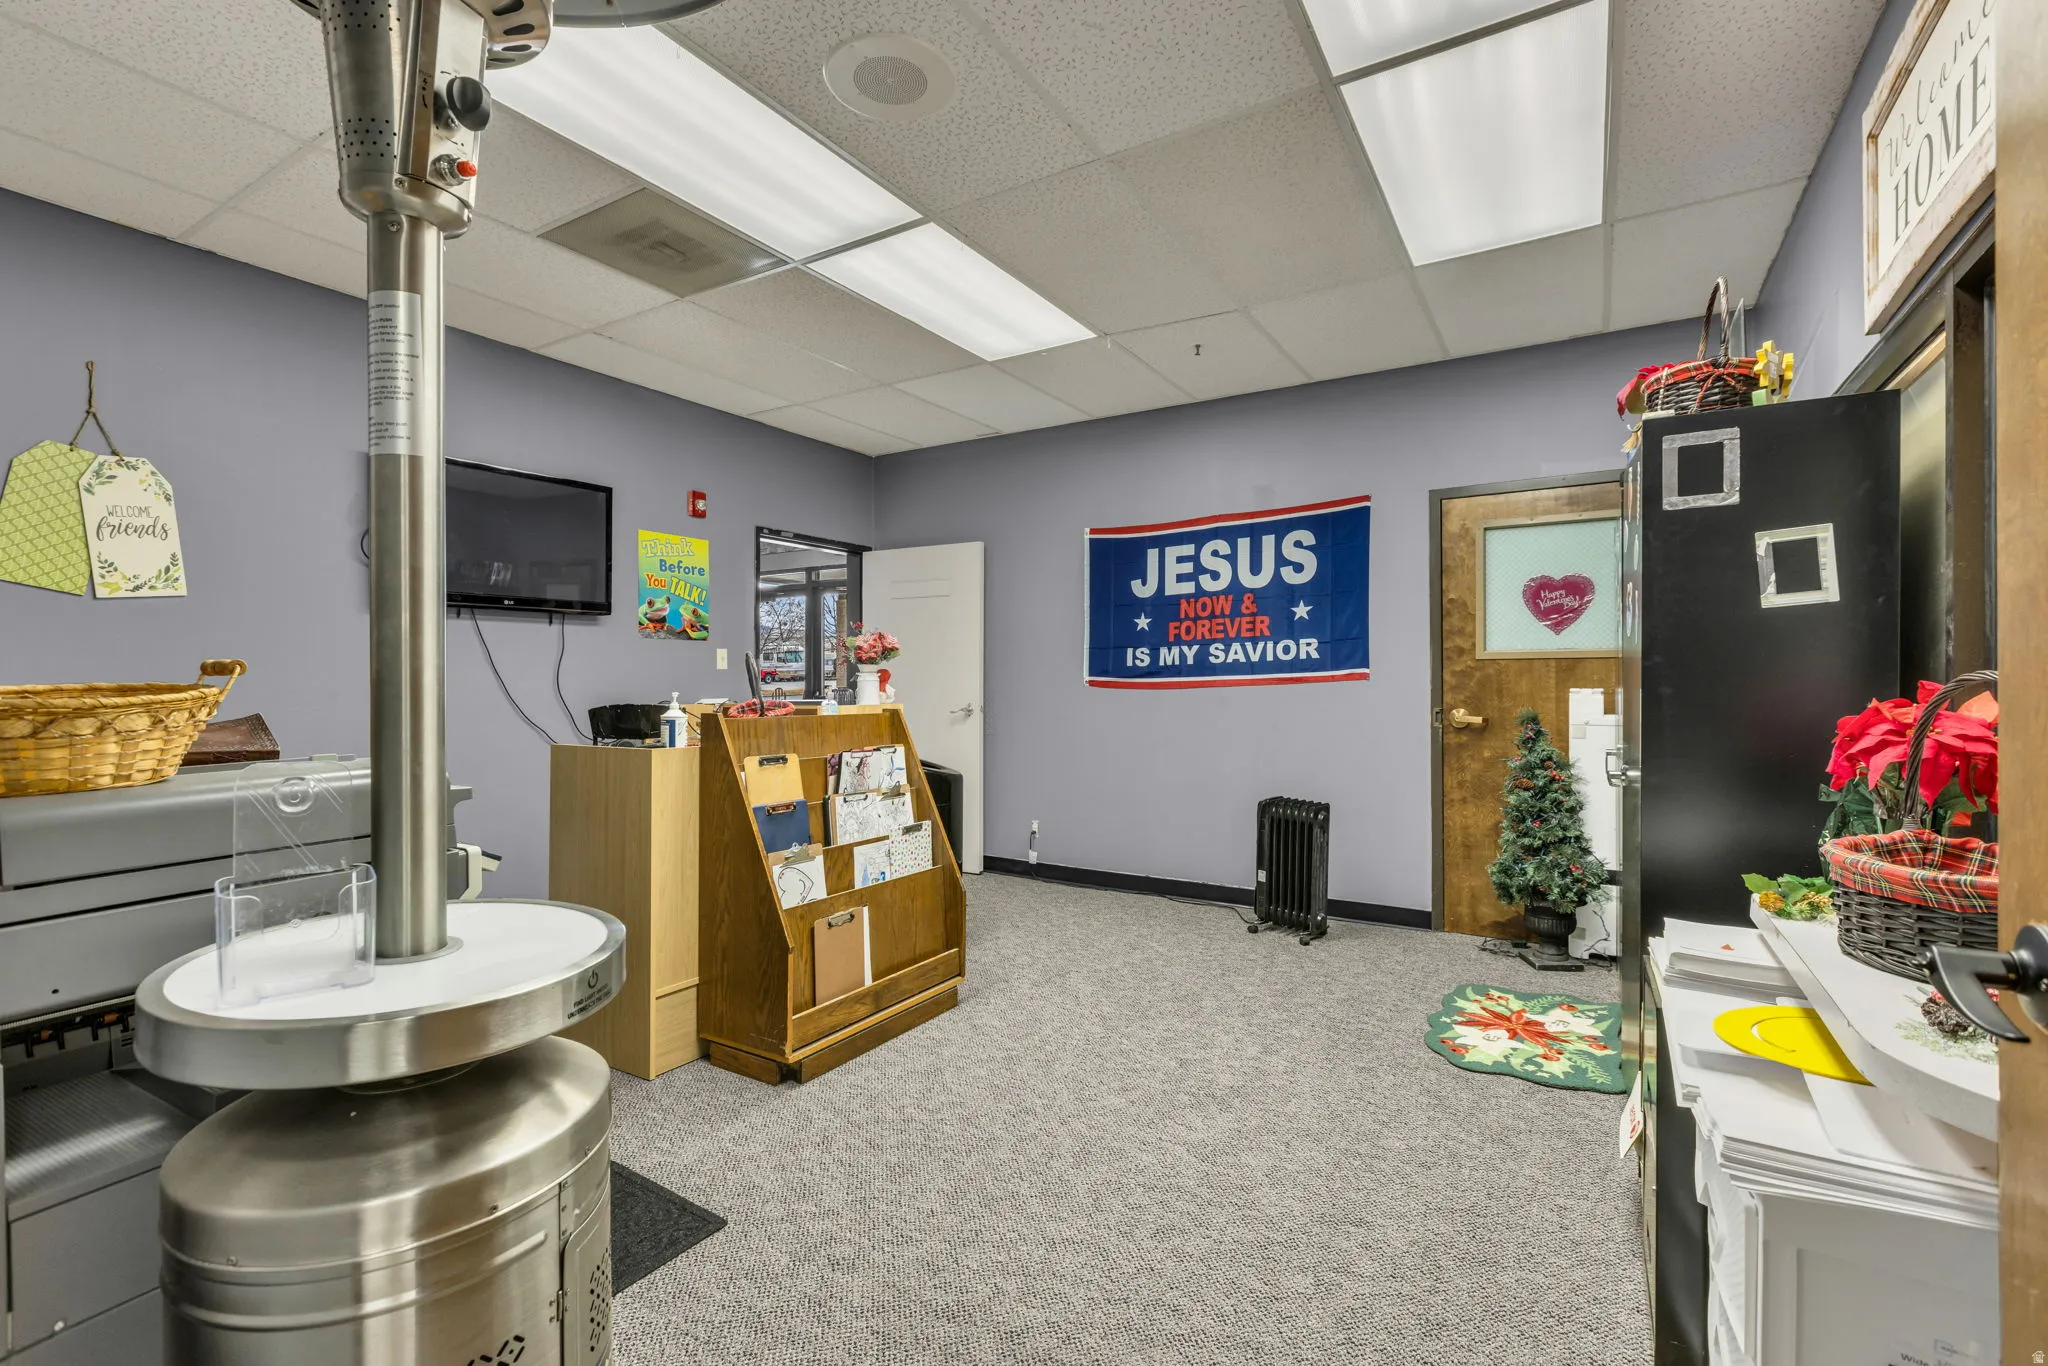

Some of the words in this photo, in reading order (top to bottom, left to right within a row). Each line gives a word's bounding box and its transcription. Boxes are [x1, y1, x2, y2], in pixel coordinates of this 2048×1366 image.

[1893, 35, 1992, 247] HOME
[106, 504, 154, 518] WELCOME
[96, 515, 172, 542] friends
[641, 537, 695, 558] Think
[659, 558, 706, 577] Before
[1130, 529, 1318, 599] JESUS
[645, 572, 669, 590] You
[670, 575, 708, 607] TALK!
[1540, 589, 1566, 600] Happy
[1179, 594, 1233, 619] NOW
[1240, 592, 1258, 615] &
[1168, 615, 1271, 643] FOREVER
[1126, 647, 1151, 667] IS
[1159, 644, 1200, 667] MY
[1208, 637, 1321, 664] SAVIOR
